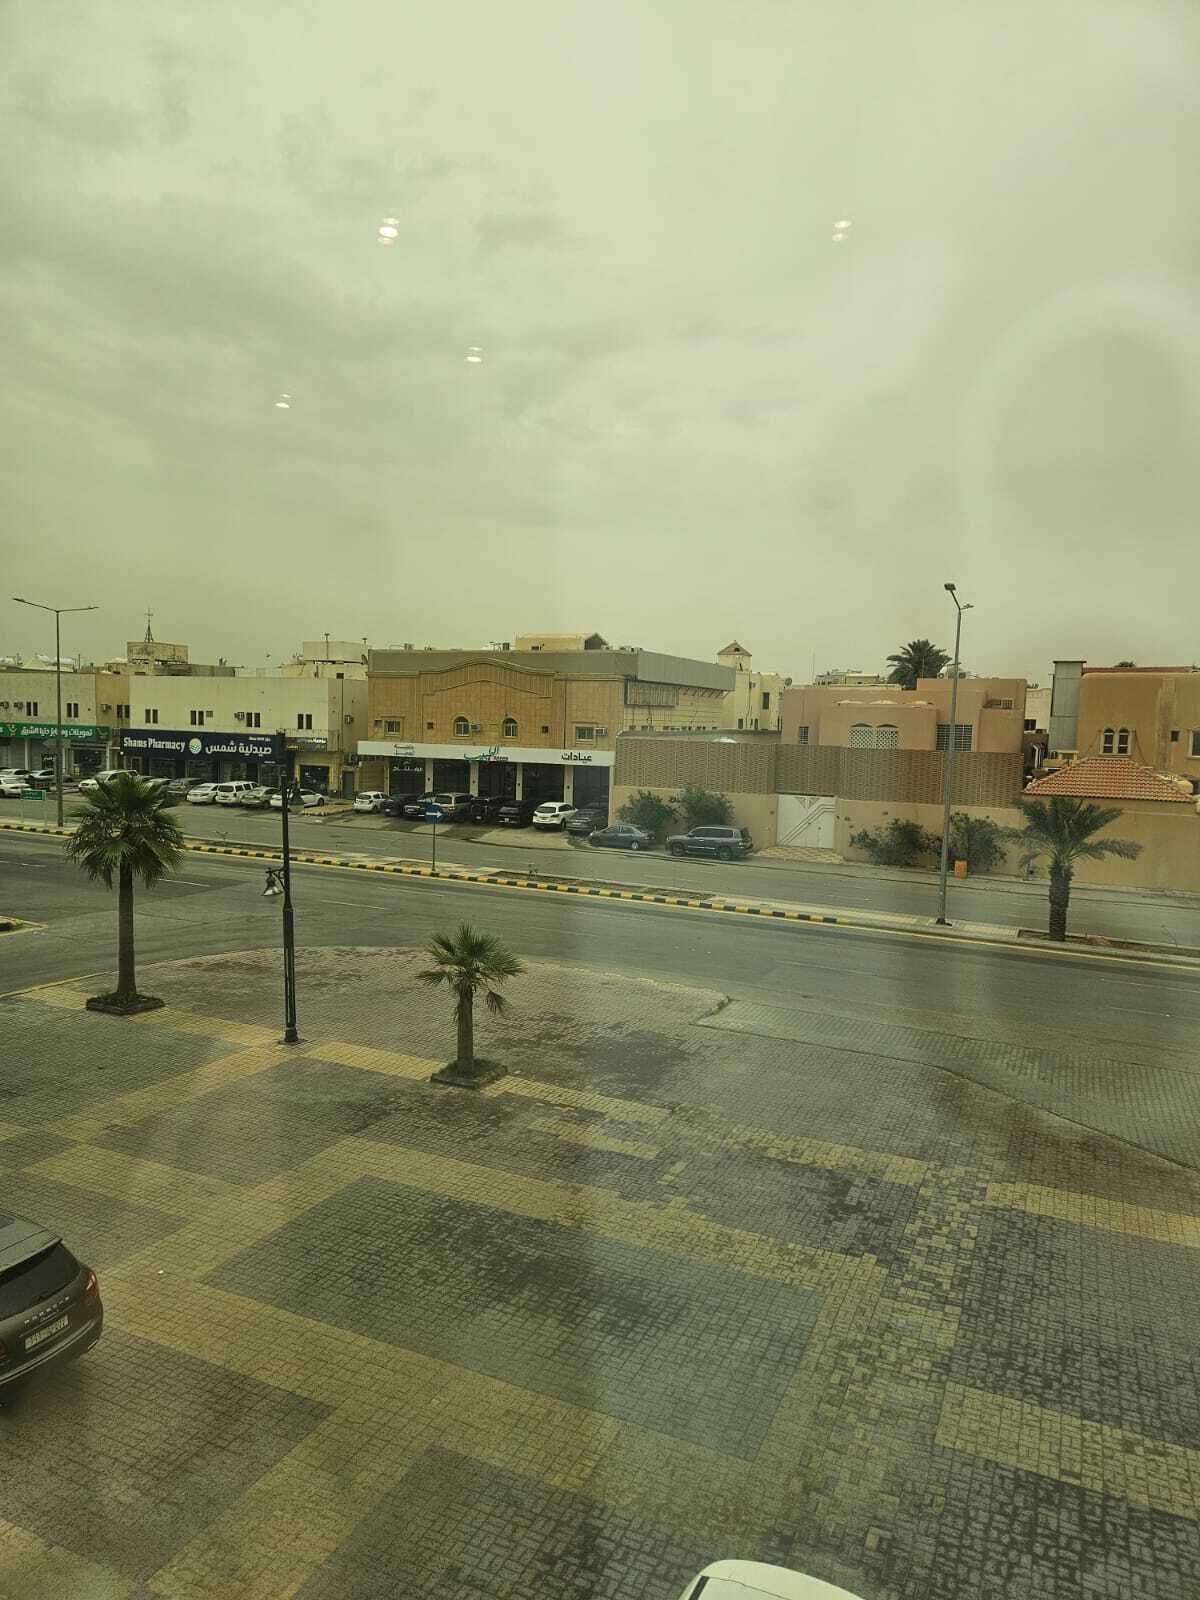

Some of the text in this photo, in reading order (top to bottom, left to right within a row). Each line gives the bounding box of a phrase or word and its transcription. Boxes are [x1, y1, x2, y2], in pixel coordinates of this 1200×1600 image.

[123, 736, 186, 752] Shams Pharmacy
[205, 740, 272, 757] صيدلية شمس
